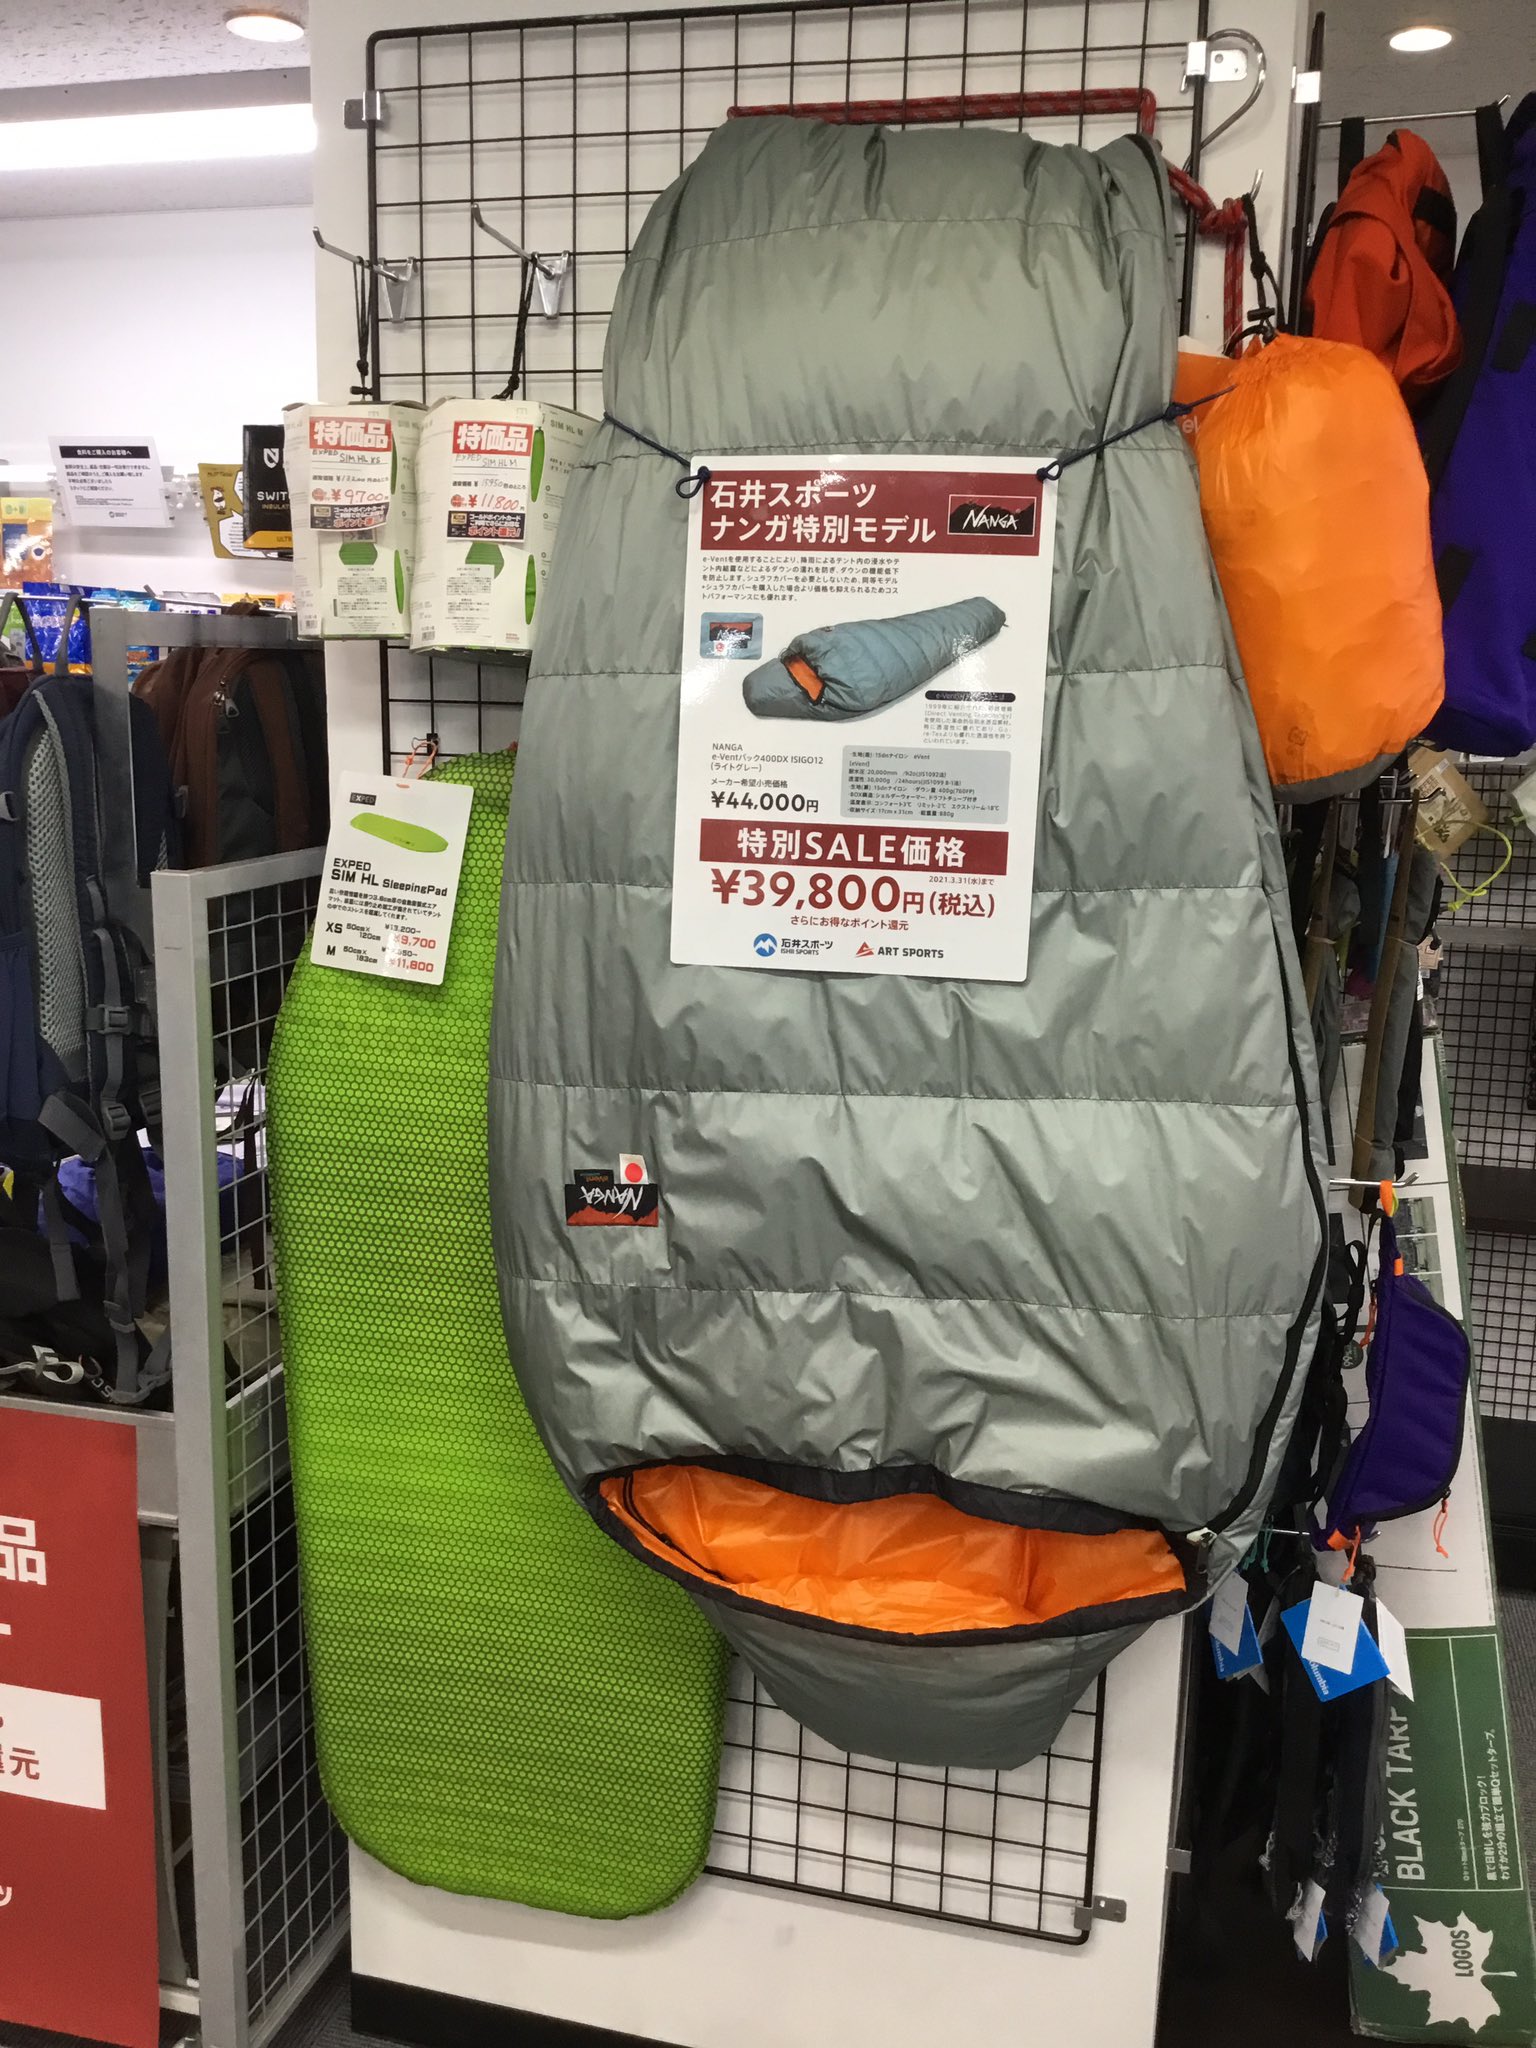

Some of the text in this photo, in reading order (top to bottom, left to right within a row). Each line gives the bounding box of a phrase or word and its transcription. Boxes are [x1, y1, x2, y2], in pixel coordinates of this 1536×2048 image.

[550, 420, 564, 430] SIM
[314, 420, 389, 448] 特価品
[457, 424, 529, 452] 特価品
[340, 454, 355, 462] SIM
[482, 458, 496, 467] SIM
[710, 478, 876, 510] 石井スポーツ
[962, 504, 1018, 531] NANGA
[709, 512, 936, 545] ナンガ特別モデル
[712, 743, 743, 751] NANGA
[712, 753, 788, 763] e-Ventパック400DX
[711, 763, 762, 772] (ライトグレー)
[711, 778, 788, 788] メーカー希望小売価格
[351, 793, 376, 806] EXPED
[711, 791, 819, 813] ¥44,000円
[737, 827, 967, 868] 特別SALE価格
[333, 858, 371, 871] EXPED
[331, 868, 448, 897] SIM HL SleepingPad
[928, 874, 995, 886] 2021.3.31(水)まで
[325, 922, 343, 934] XS
[790, 915, 910, 931] さらにお得なポイント還元
[781, 937, 833, 950] 石井スポーツ
[326, 945, 336, 956] M
[795, 948, 820, 956] SPORTS
[877, 946, 944, 959] ART SPORTS
[579, 1186, 644, 1219] NANGA
[1308, 1661, 1329, 1696] olumbia
[0, 1745, 41, 1781] 元
[1389, 1786, 1425, 1882] BLACK
[1454, 1928, 1473, 1978] LOGOS
